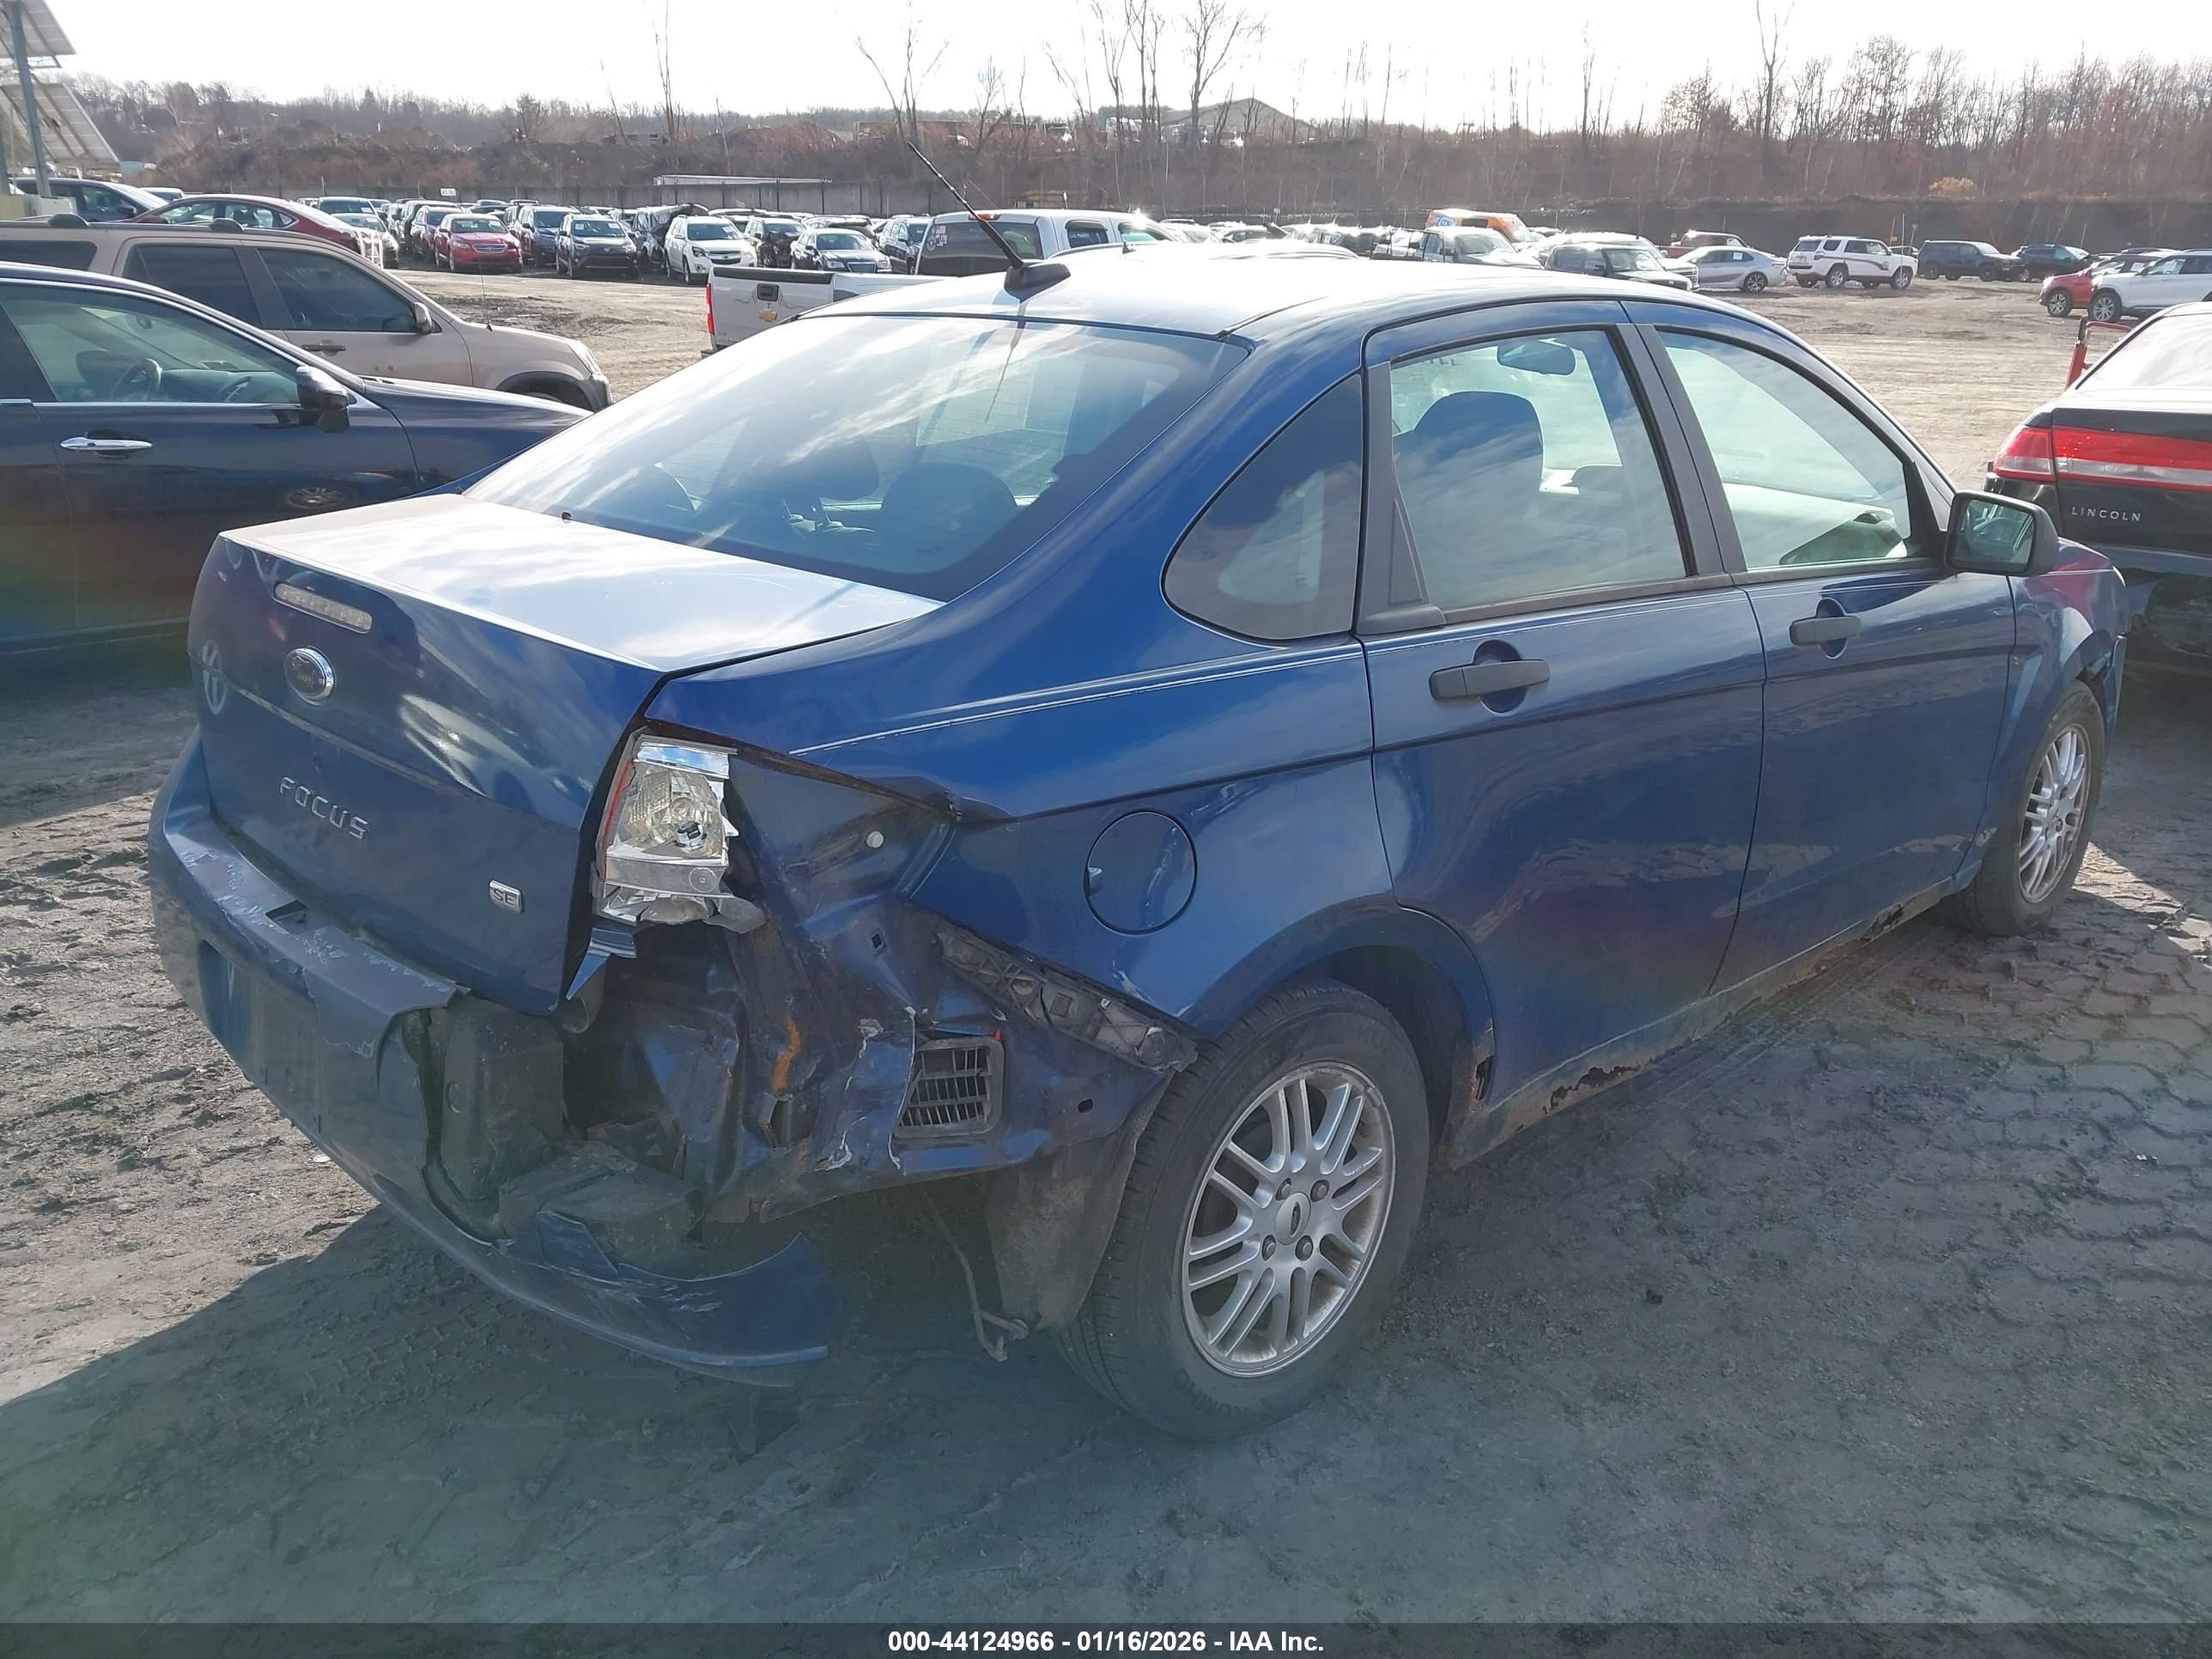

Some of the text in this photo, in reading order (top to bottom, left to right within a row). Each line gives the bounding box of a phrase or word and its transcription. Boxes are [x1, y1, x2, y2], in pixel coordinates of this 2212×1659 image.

[2071, 506, 2142, 522] LINCOLN
[279, 776, 369, 840] FOCUS
[493, 888, 518, 907] SE
